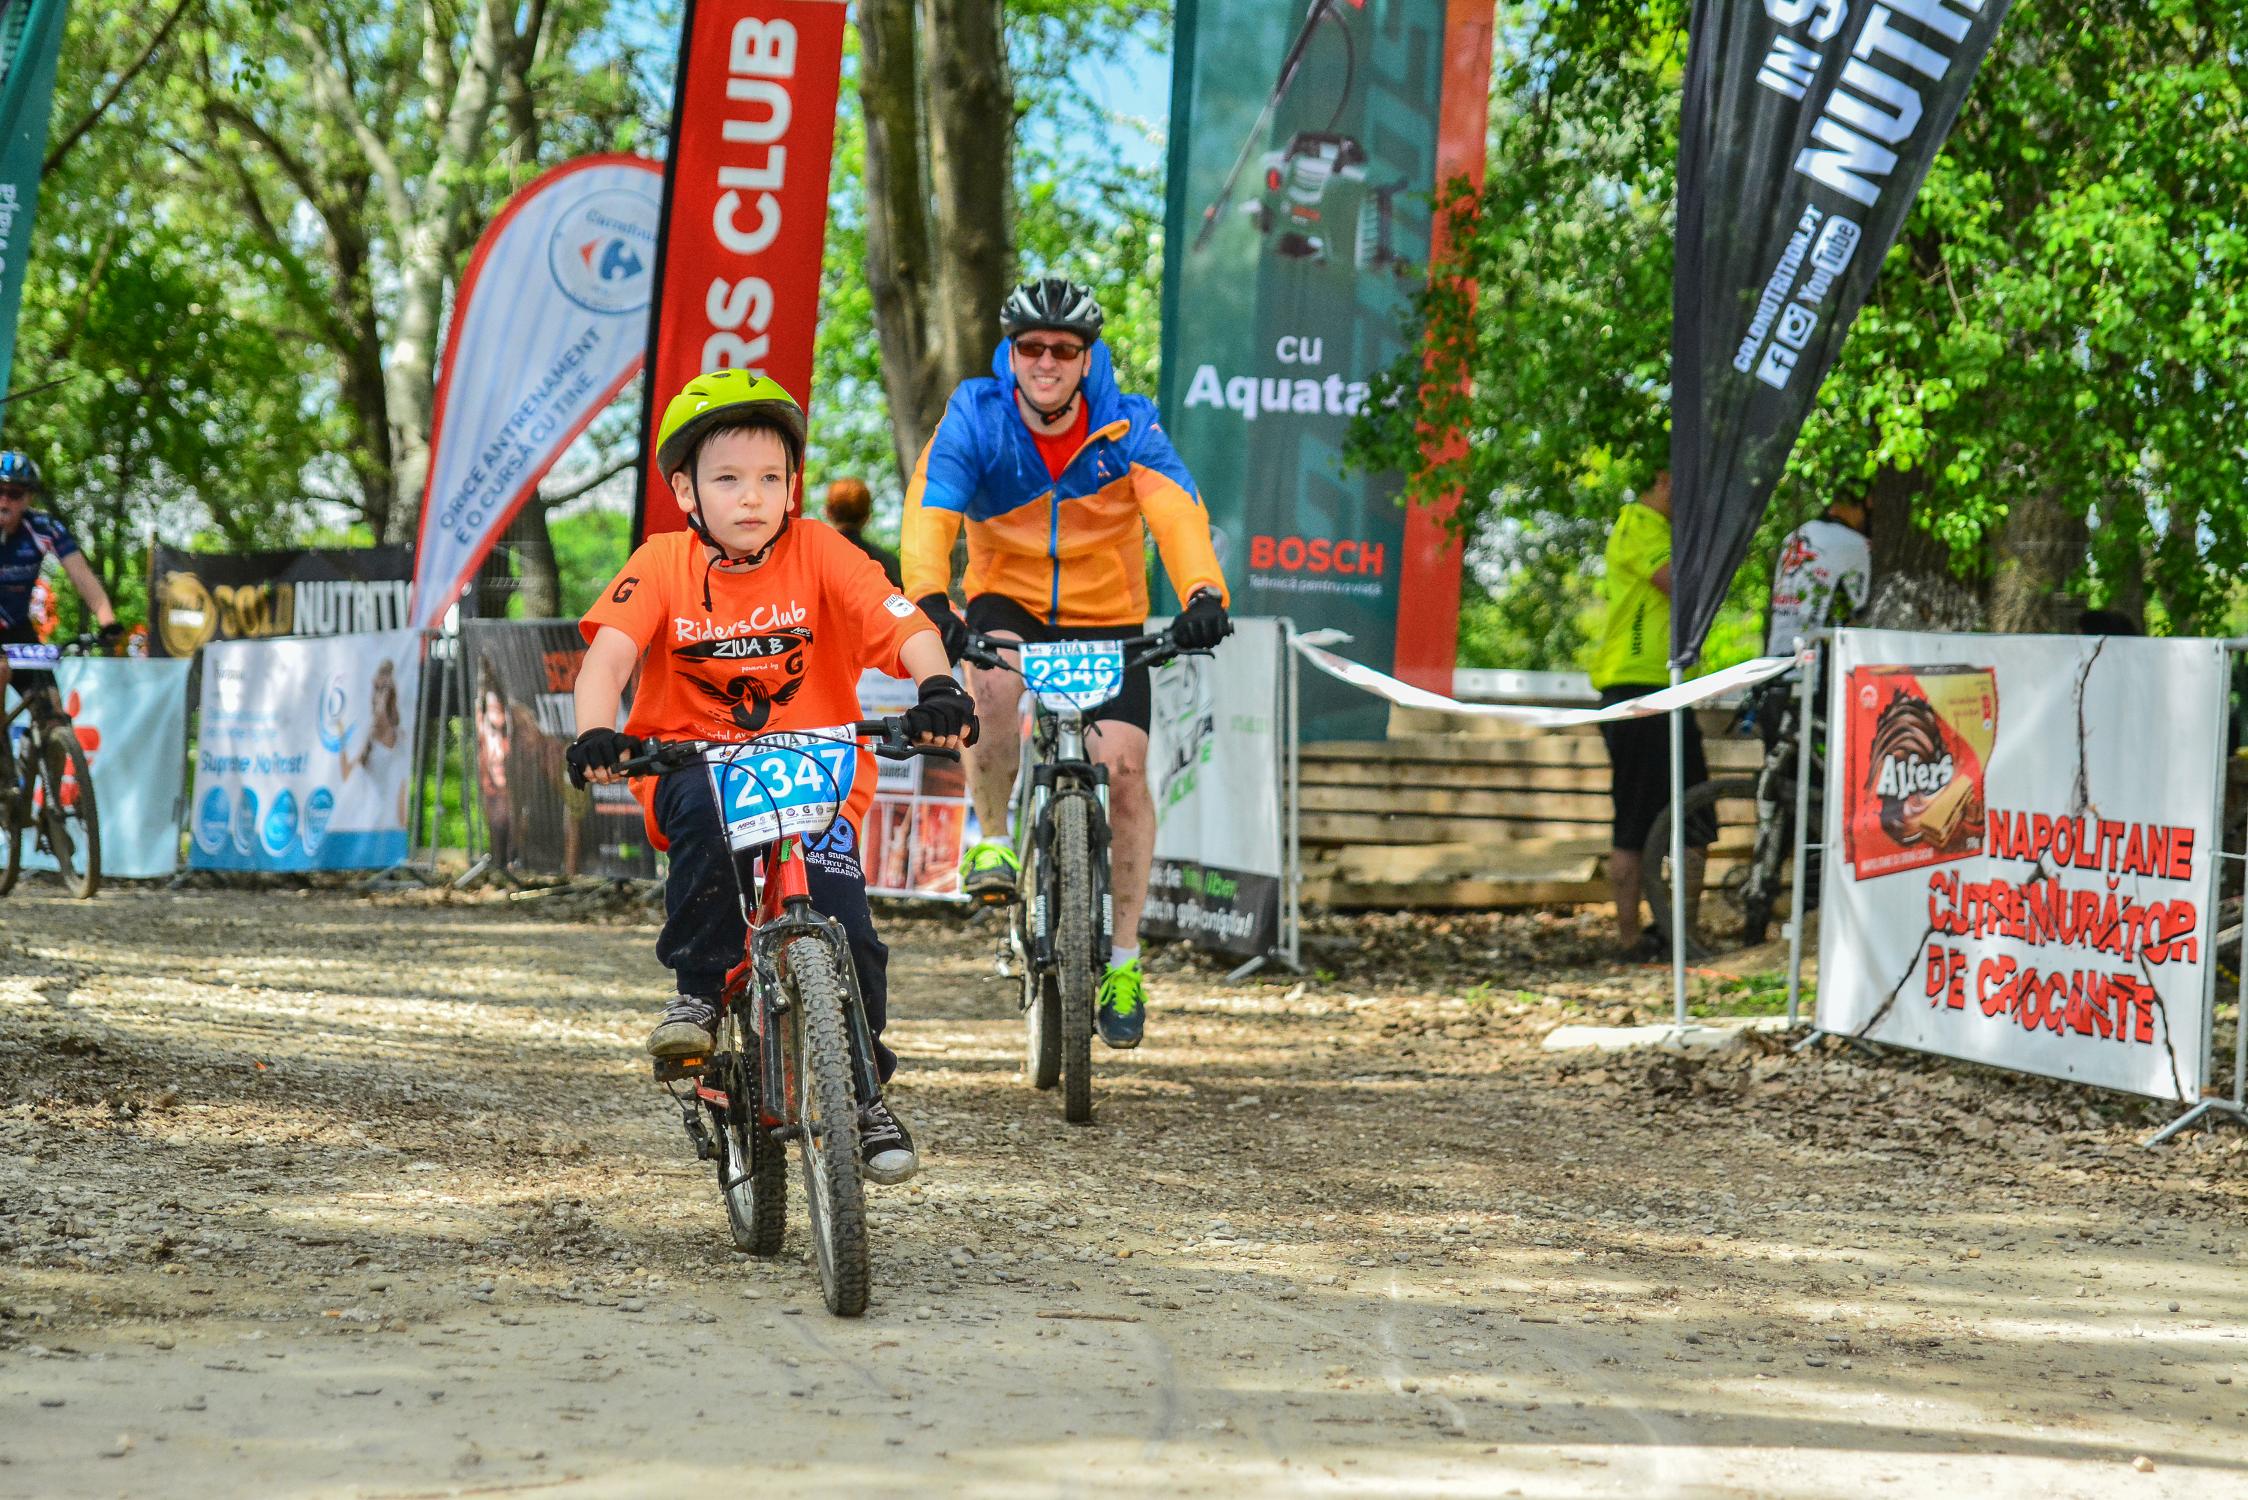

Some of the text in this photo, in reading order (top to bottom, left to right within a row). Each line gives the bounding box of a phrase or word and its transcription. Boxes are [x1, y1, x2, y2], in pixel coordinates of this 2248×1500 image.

[1756, 34, 1823, 101] IN
[712, 16, 799, 256] CLUB
[1276, 335, 1323, 365] cu
[440, 325, 601, 529] ORICE ANTRENAMENT
[455, 526, 471, 546] E
[551, 371, 595, 417] TINE
[1250, 535, 1385, 577] BOSCH
[612, 576, 640, 604] G
[673, 600, 807, 643] RidersClub
[712, 637, 784, 657] ZIUA B
[1031, 657, 1114, 687] 2346
[729, 748, 846, 809] 2347
[1876, 753, 1955, 800] Alfers
[1987, 808, 2195, 882] NAPOLITANE
[1927, 869, 2198, 966] CUTREMURĂTOR
[1926, 943, 2155, 1045] DE CROCANTE
